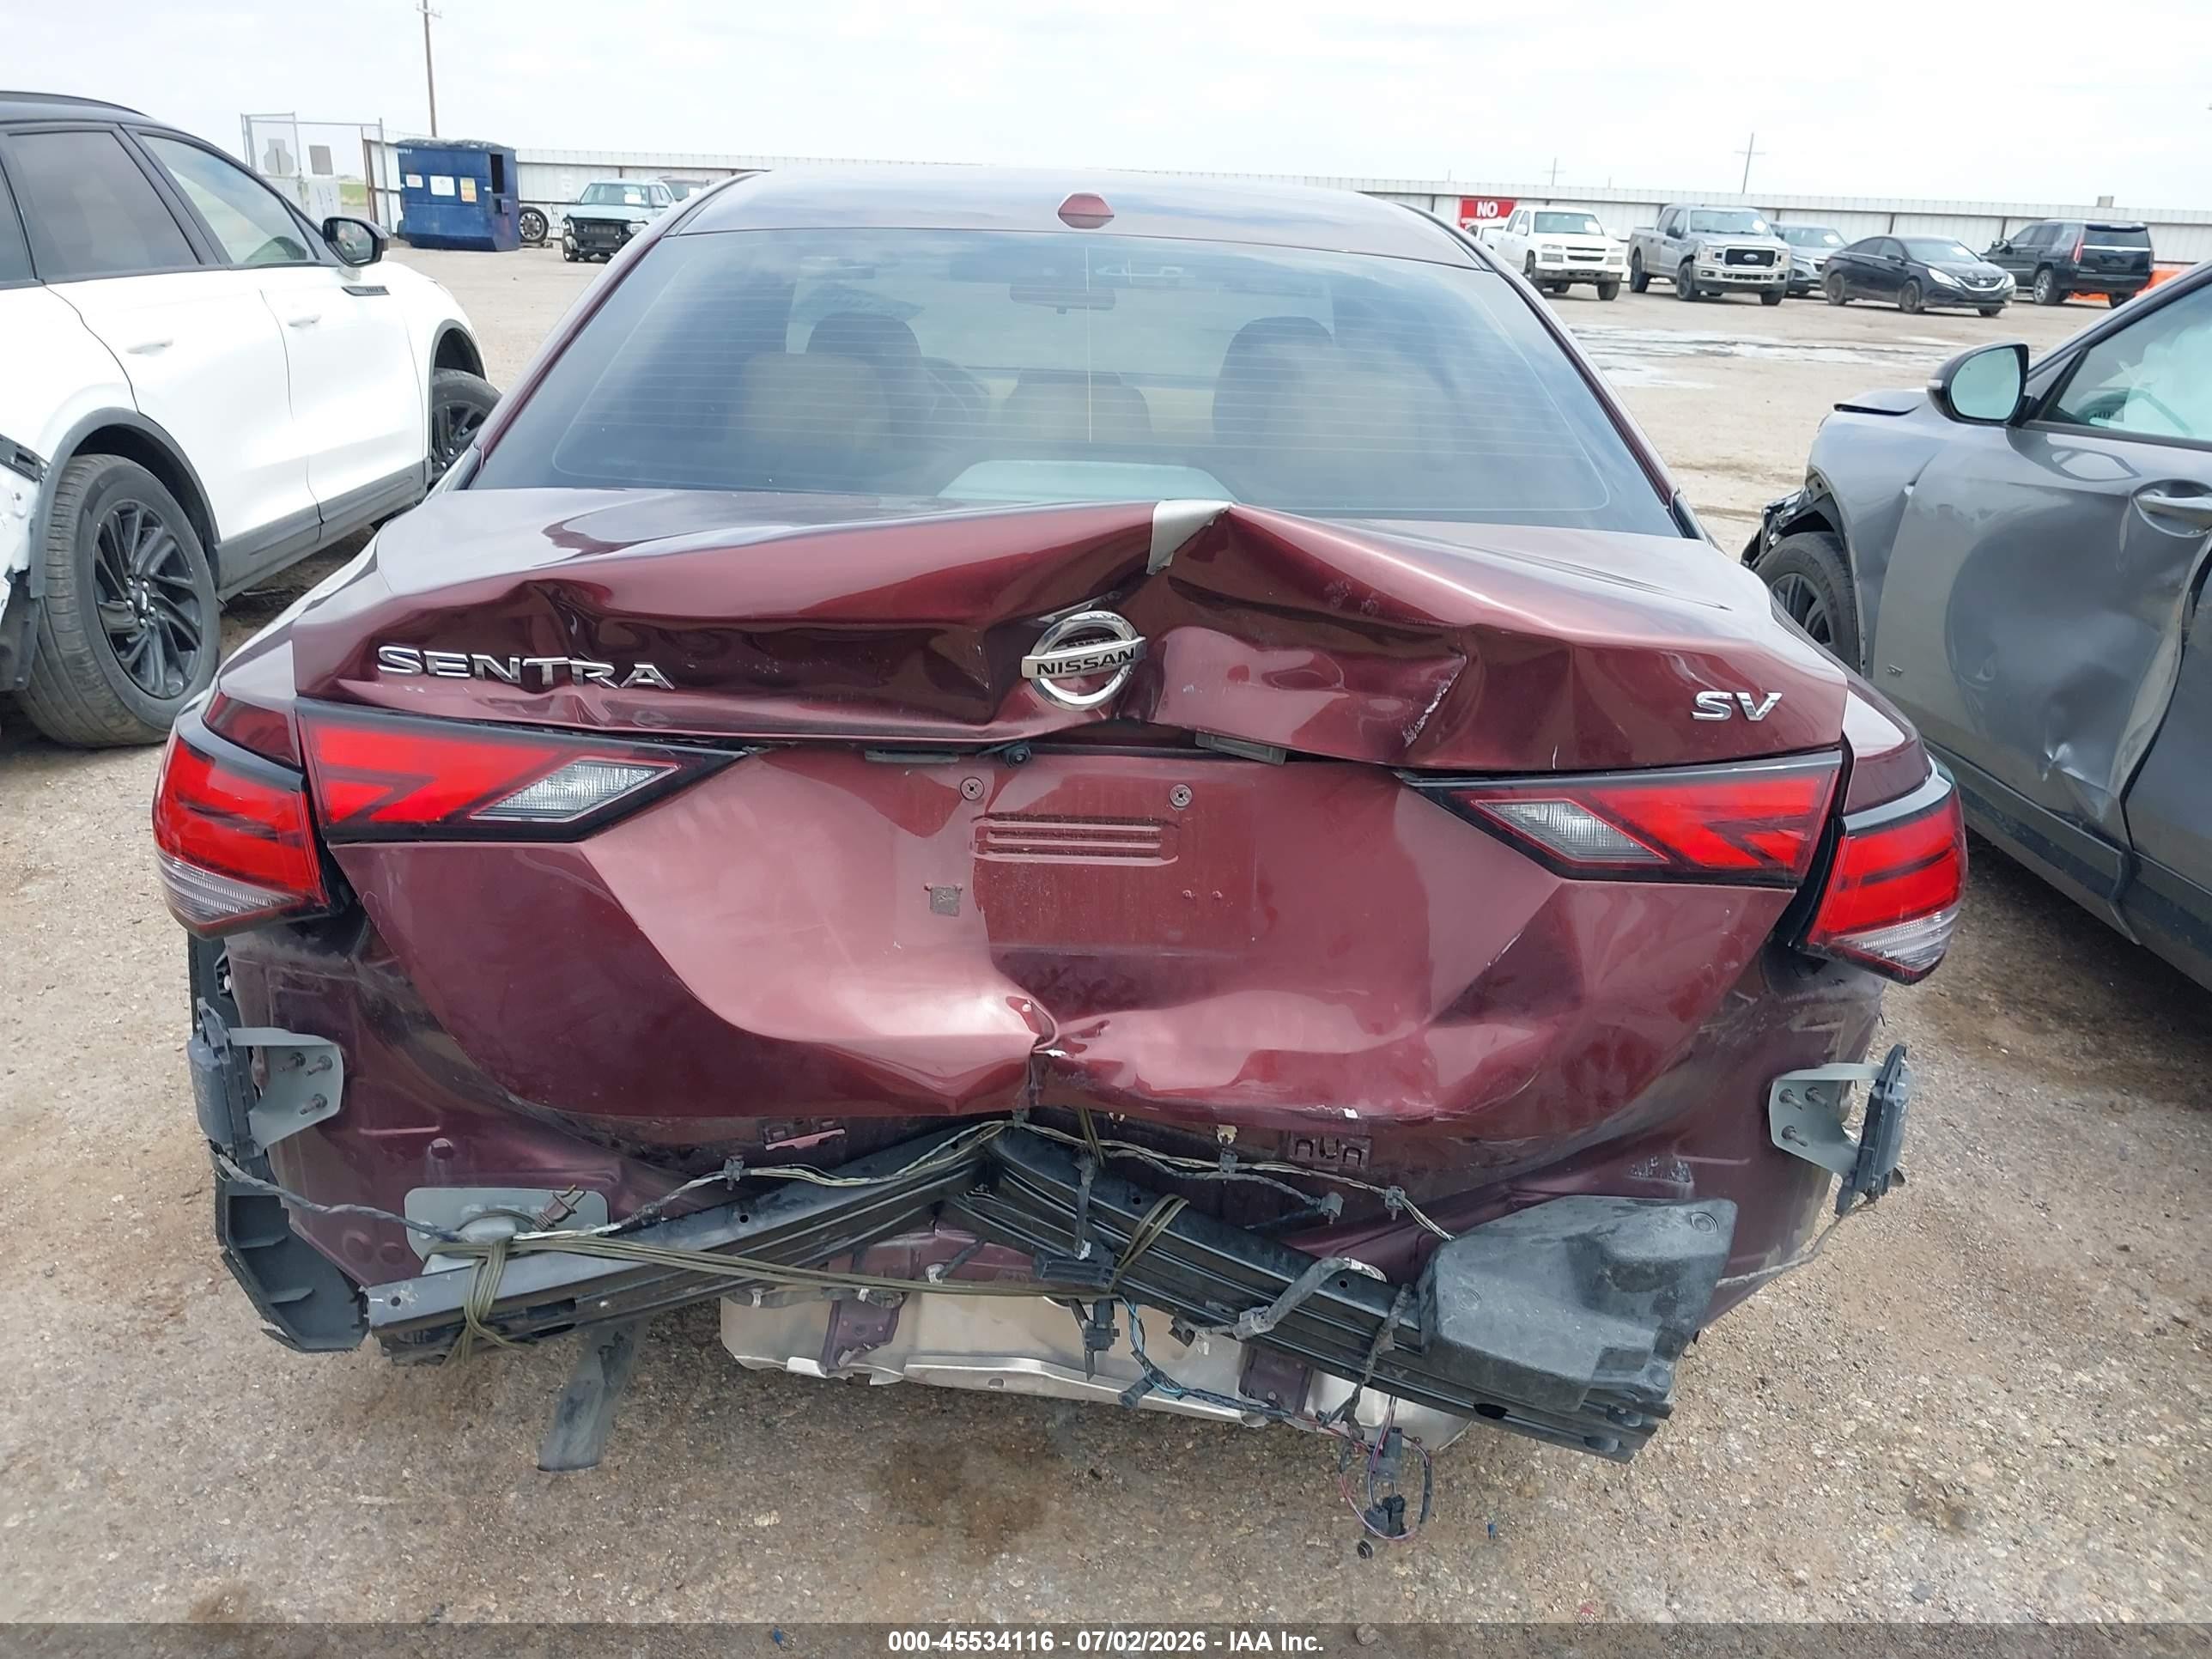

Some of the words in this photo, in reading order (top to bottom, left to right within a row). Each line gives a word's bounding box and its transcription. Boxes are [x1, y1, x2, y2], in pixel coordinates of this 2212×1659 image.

[1477, 201, 1498, 218] NO
[378, 645, 675, 690] SENTRA
[1036, 647, 1134, 676] NISSAN
[1691, 690, 1783, 721] SV
